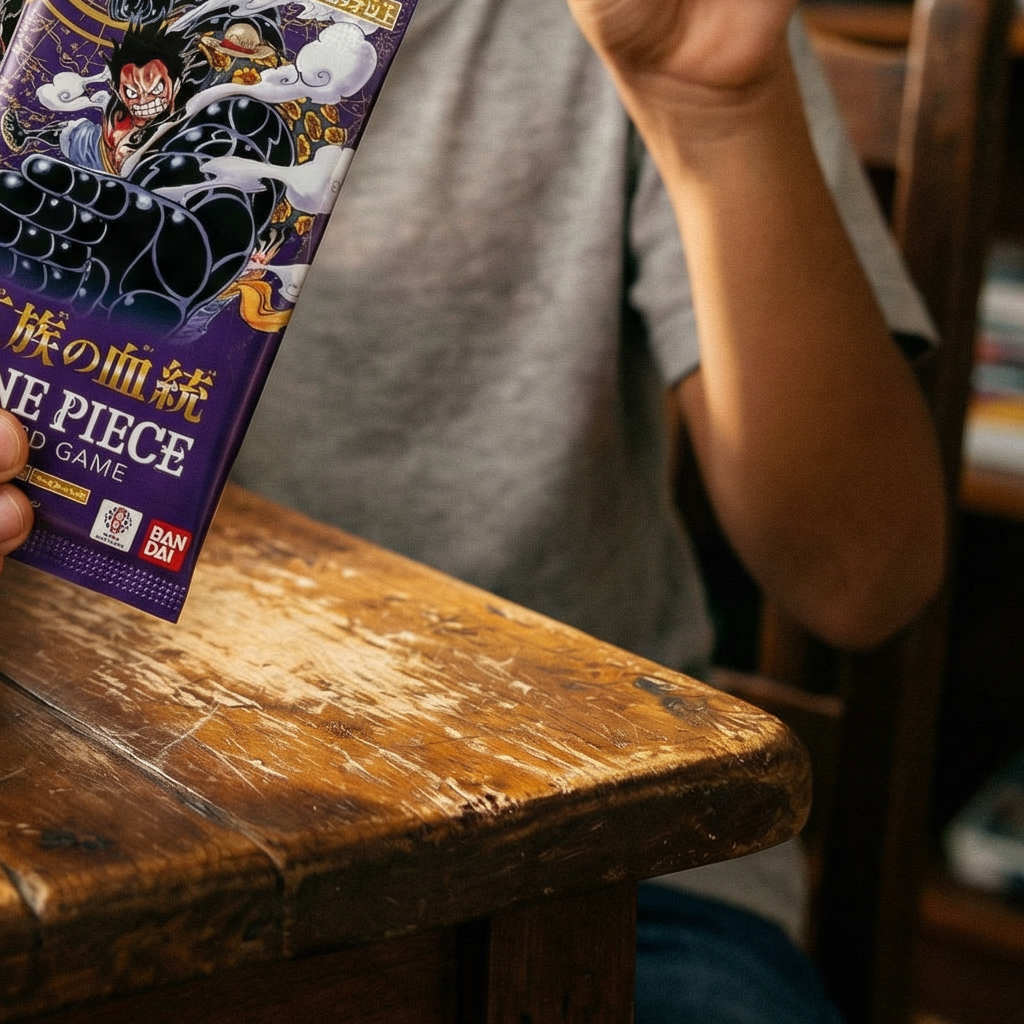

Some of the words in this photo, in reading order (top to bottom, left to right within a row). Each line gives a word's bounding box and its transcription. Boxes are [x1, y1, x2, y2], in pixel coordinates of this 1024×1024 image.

[49, 388, 195, 478] PIECE
[55, 441, 128, 483] GAME
[143, 539, 175, 564] DAI
[149, 525, 188, 552] BAN
